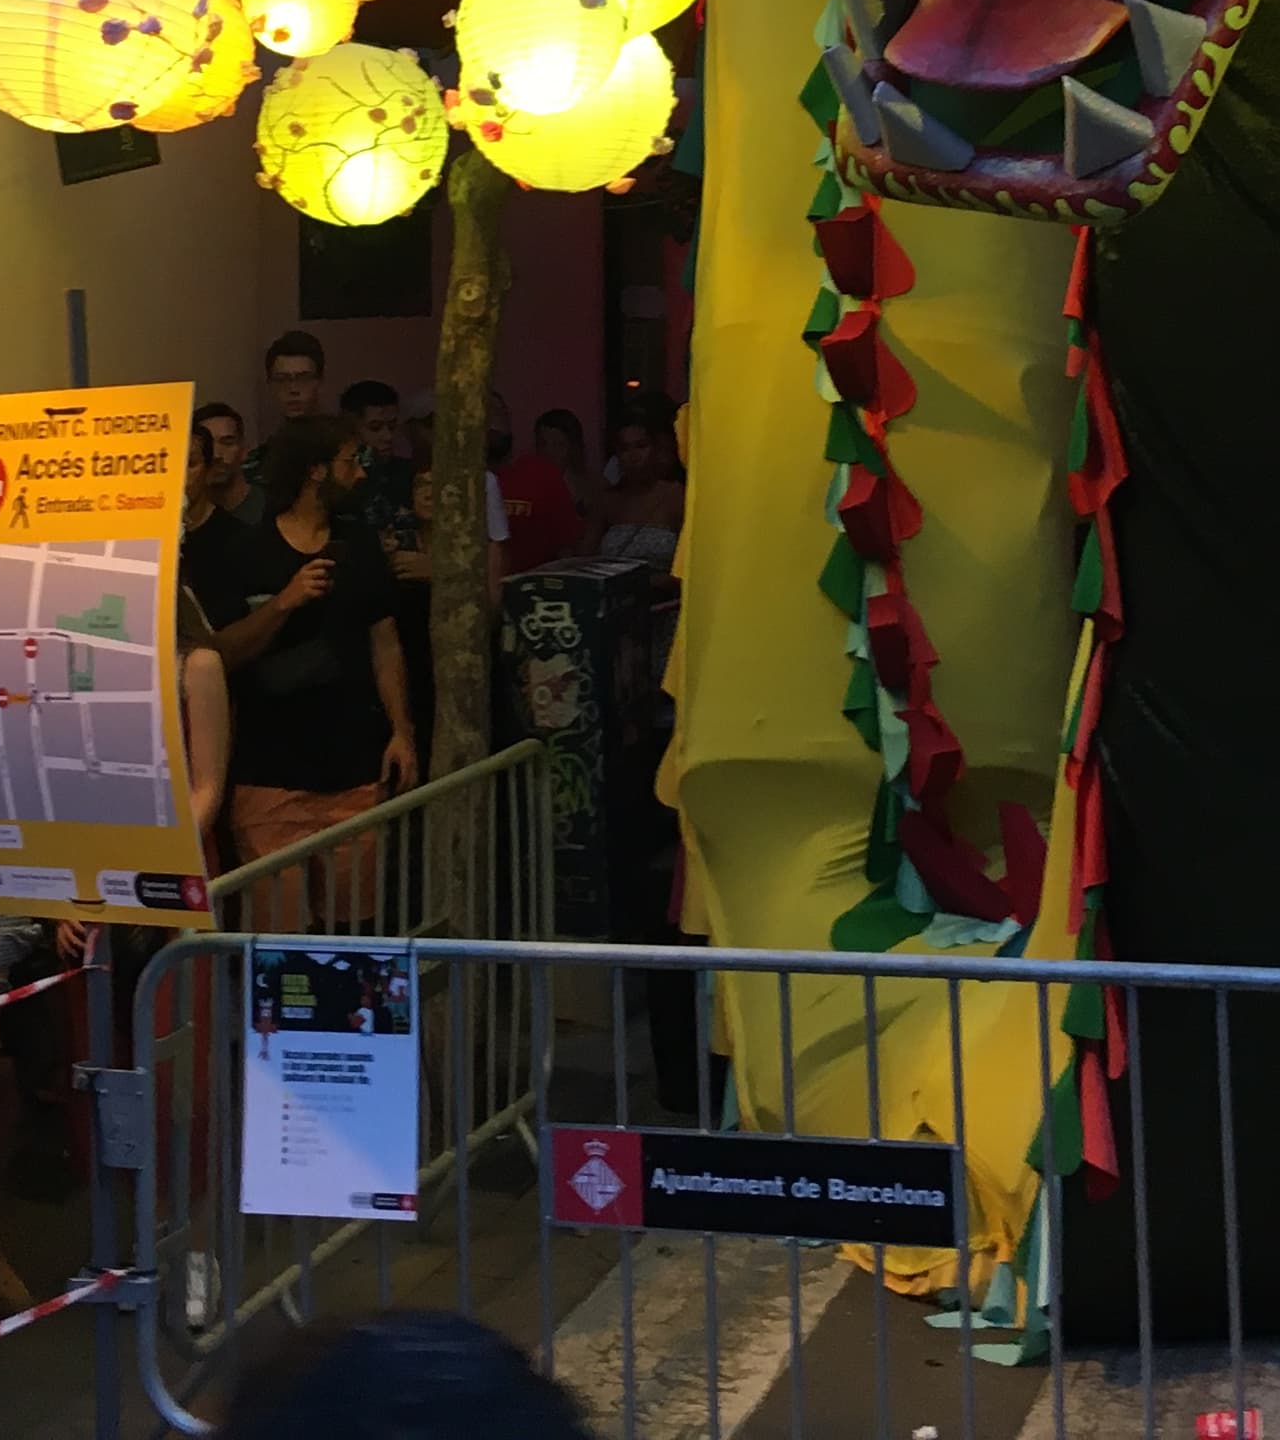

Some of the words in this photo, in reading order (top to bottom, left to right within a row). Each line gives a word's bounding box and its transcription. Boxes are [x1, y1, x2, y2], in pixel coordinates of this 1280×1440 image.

[72, 417, 88, 437] C.
[93, 414, 170, 435] TORDERA
[15, 449, 86, 480] Accés
[91, 447, 169, 477] tancat
[650, 1166, 785, 1197] Ajuntament
[791, 1176, 821, 1200] de
[827, 1177, 946, 1208] Barcelona
